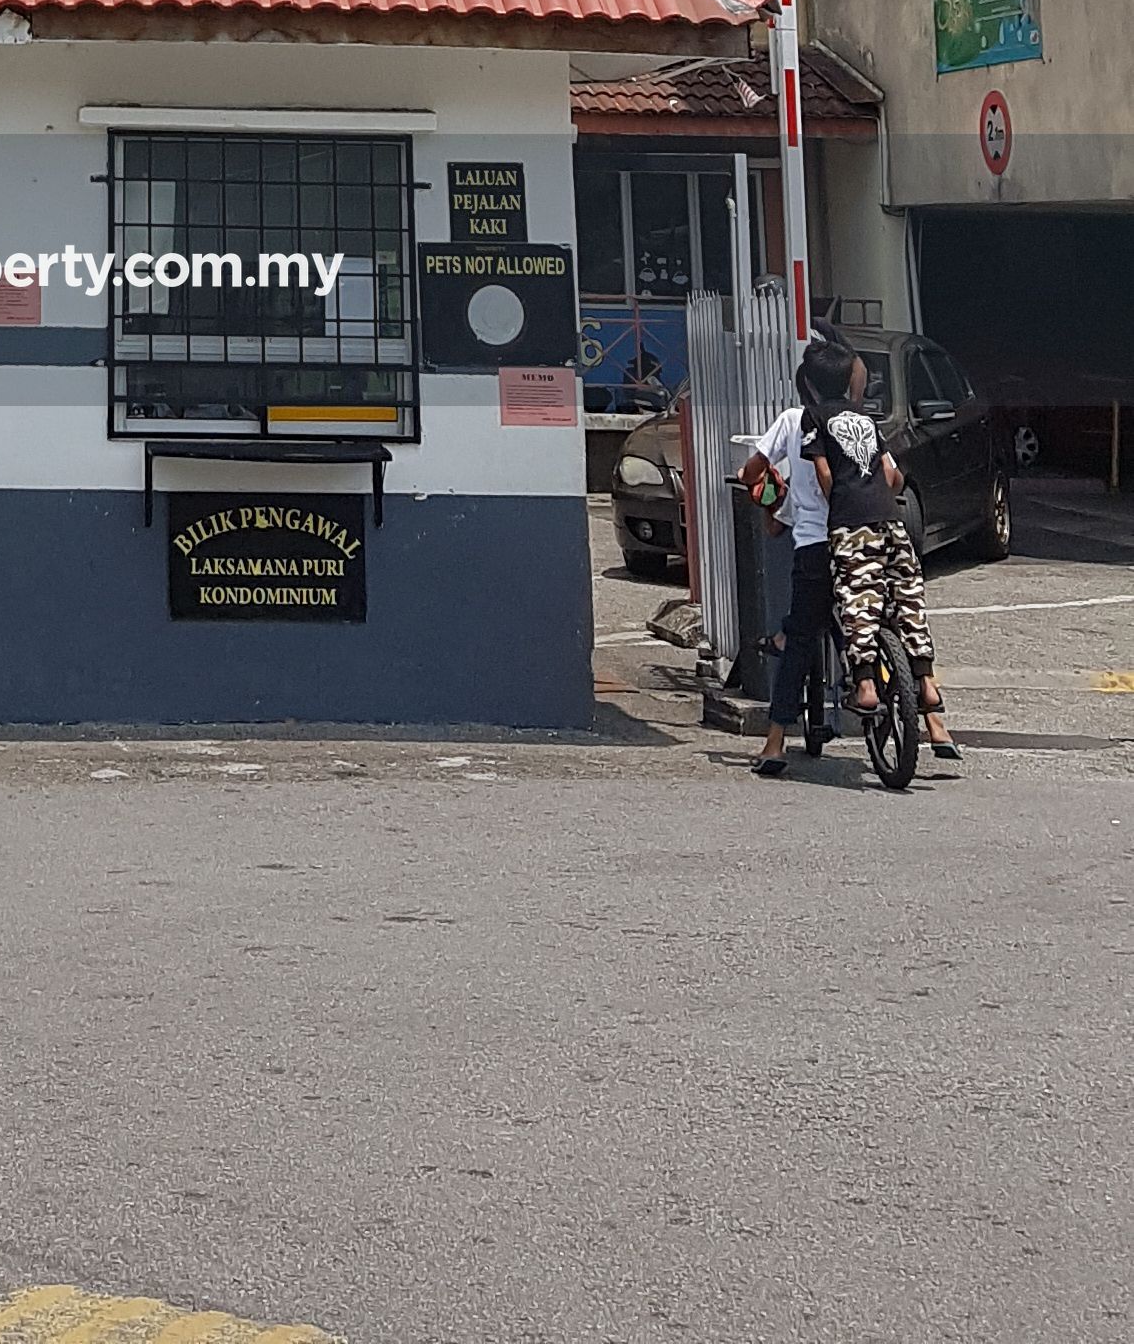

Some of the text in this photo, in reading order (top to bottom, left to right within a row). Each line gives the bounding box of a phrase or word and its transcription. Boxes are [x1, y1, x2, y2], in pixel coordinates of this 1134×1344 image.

[454, 169, 518, 186] LALUAN
[453, 193, 522, 214] PEJALAN
[469, 218, 508, 235] KAKI
[426, 255, 566, 275] PETS NOT ALLOWED
[521, 373, 555, 382] MEMO
[172, 506, 362, 560] BILIK PENGAWAL
[190, 557, 345, 577] LAKSAMANA PURI
[199, 586, 338, 606] KONDOMINIUM
